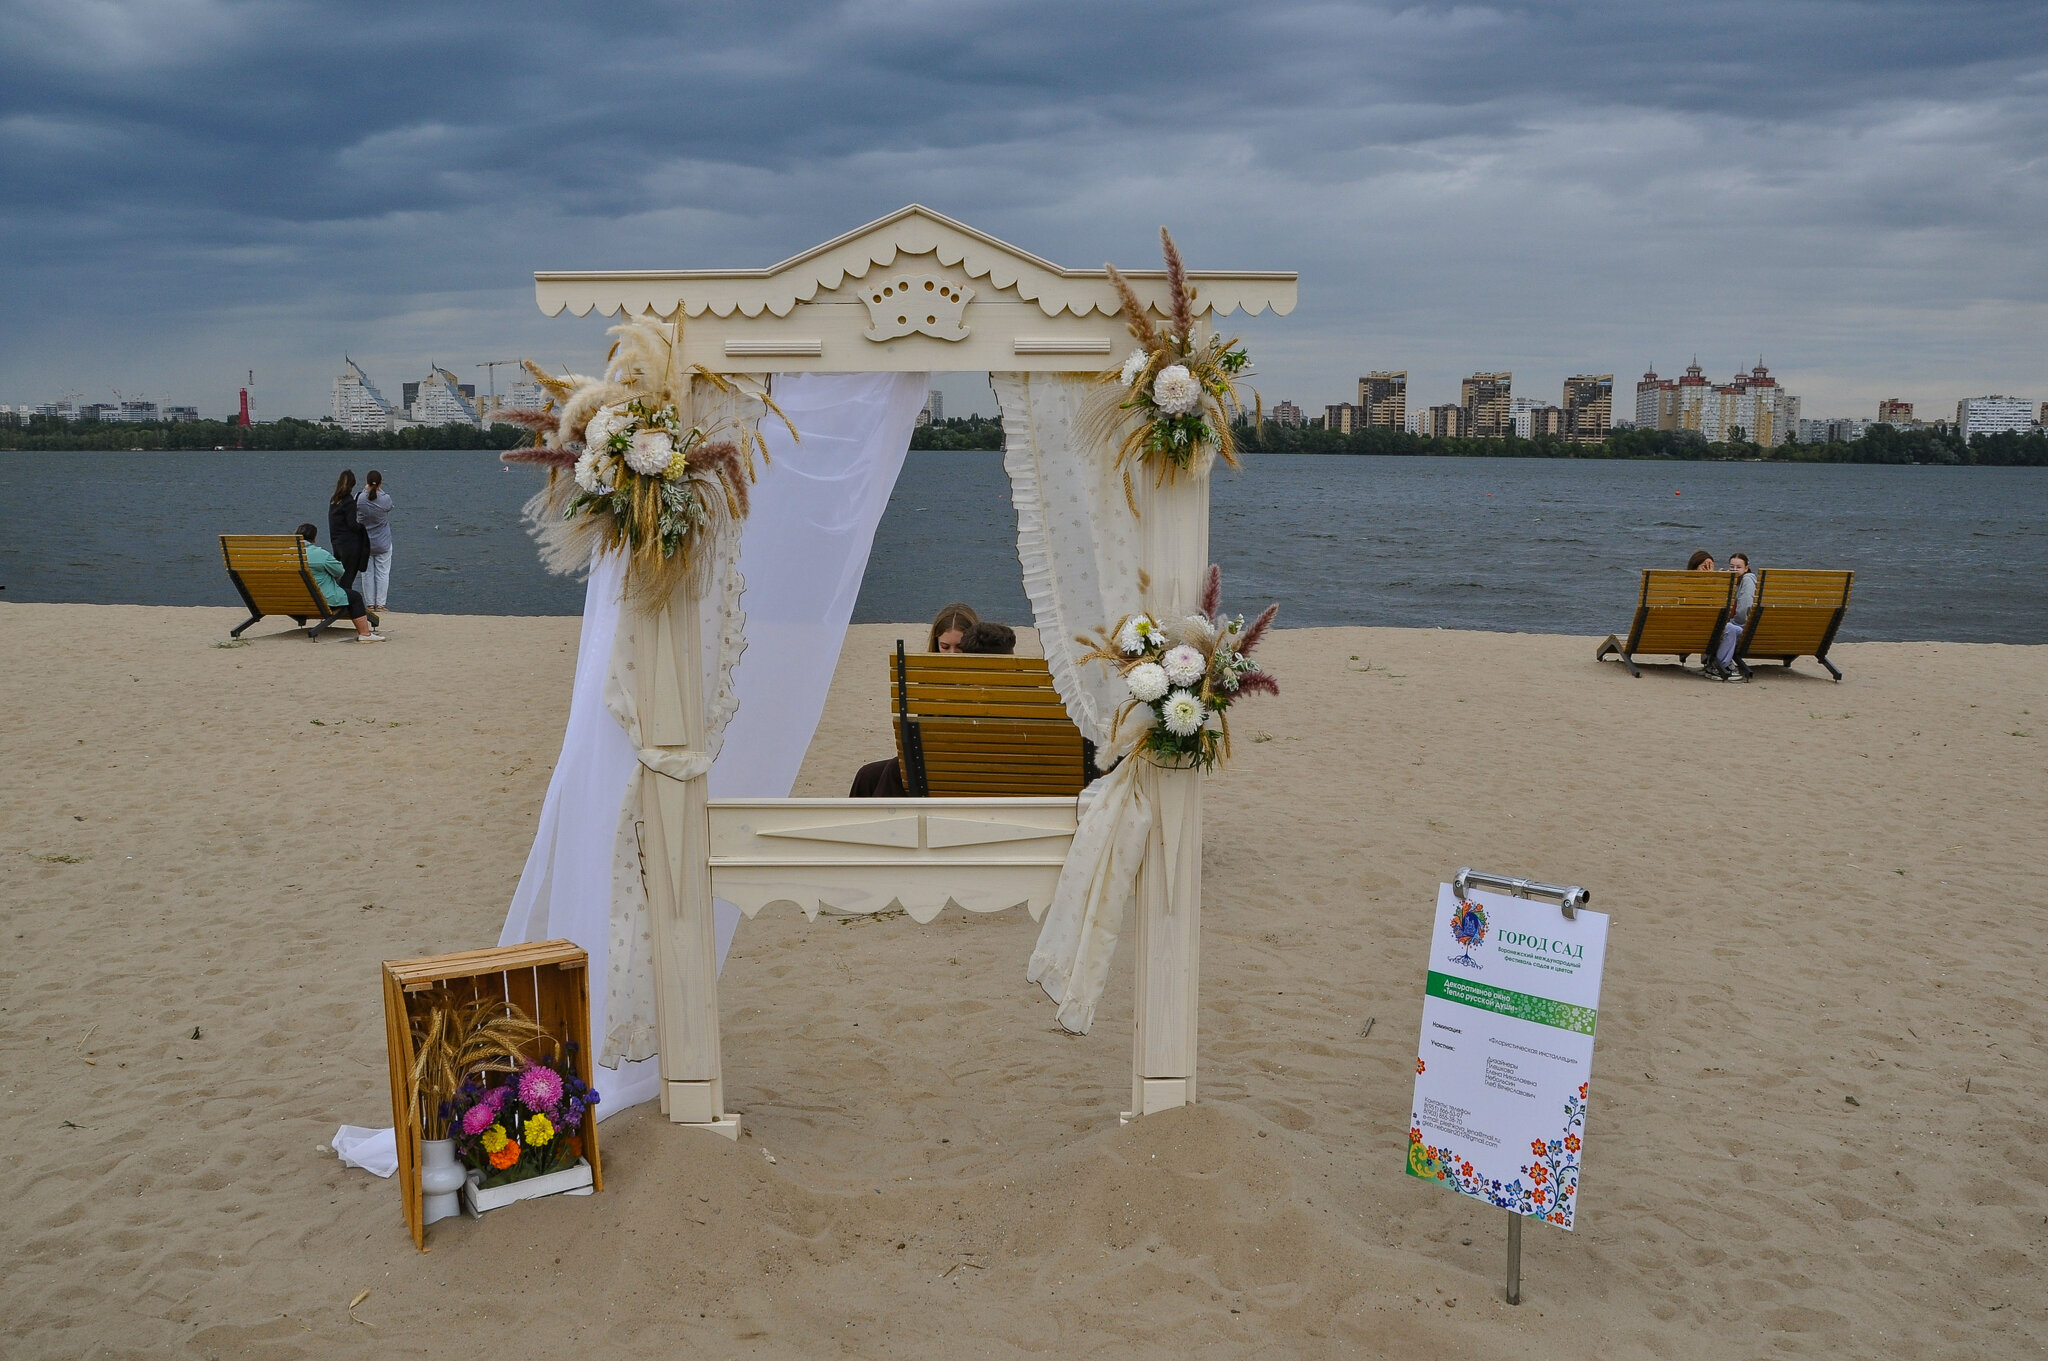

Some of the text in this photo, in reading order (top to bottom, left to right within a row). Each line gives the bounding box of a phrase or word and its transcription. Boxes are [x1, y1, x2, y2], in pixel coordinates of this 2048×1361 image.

[1498, 929, 1584, 960] ГОРОД САД
[1444, 979, 1511, 1002] Декоративное окно
[1465, 993, 1495, 1007] русской
